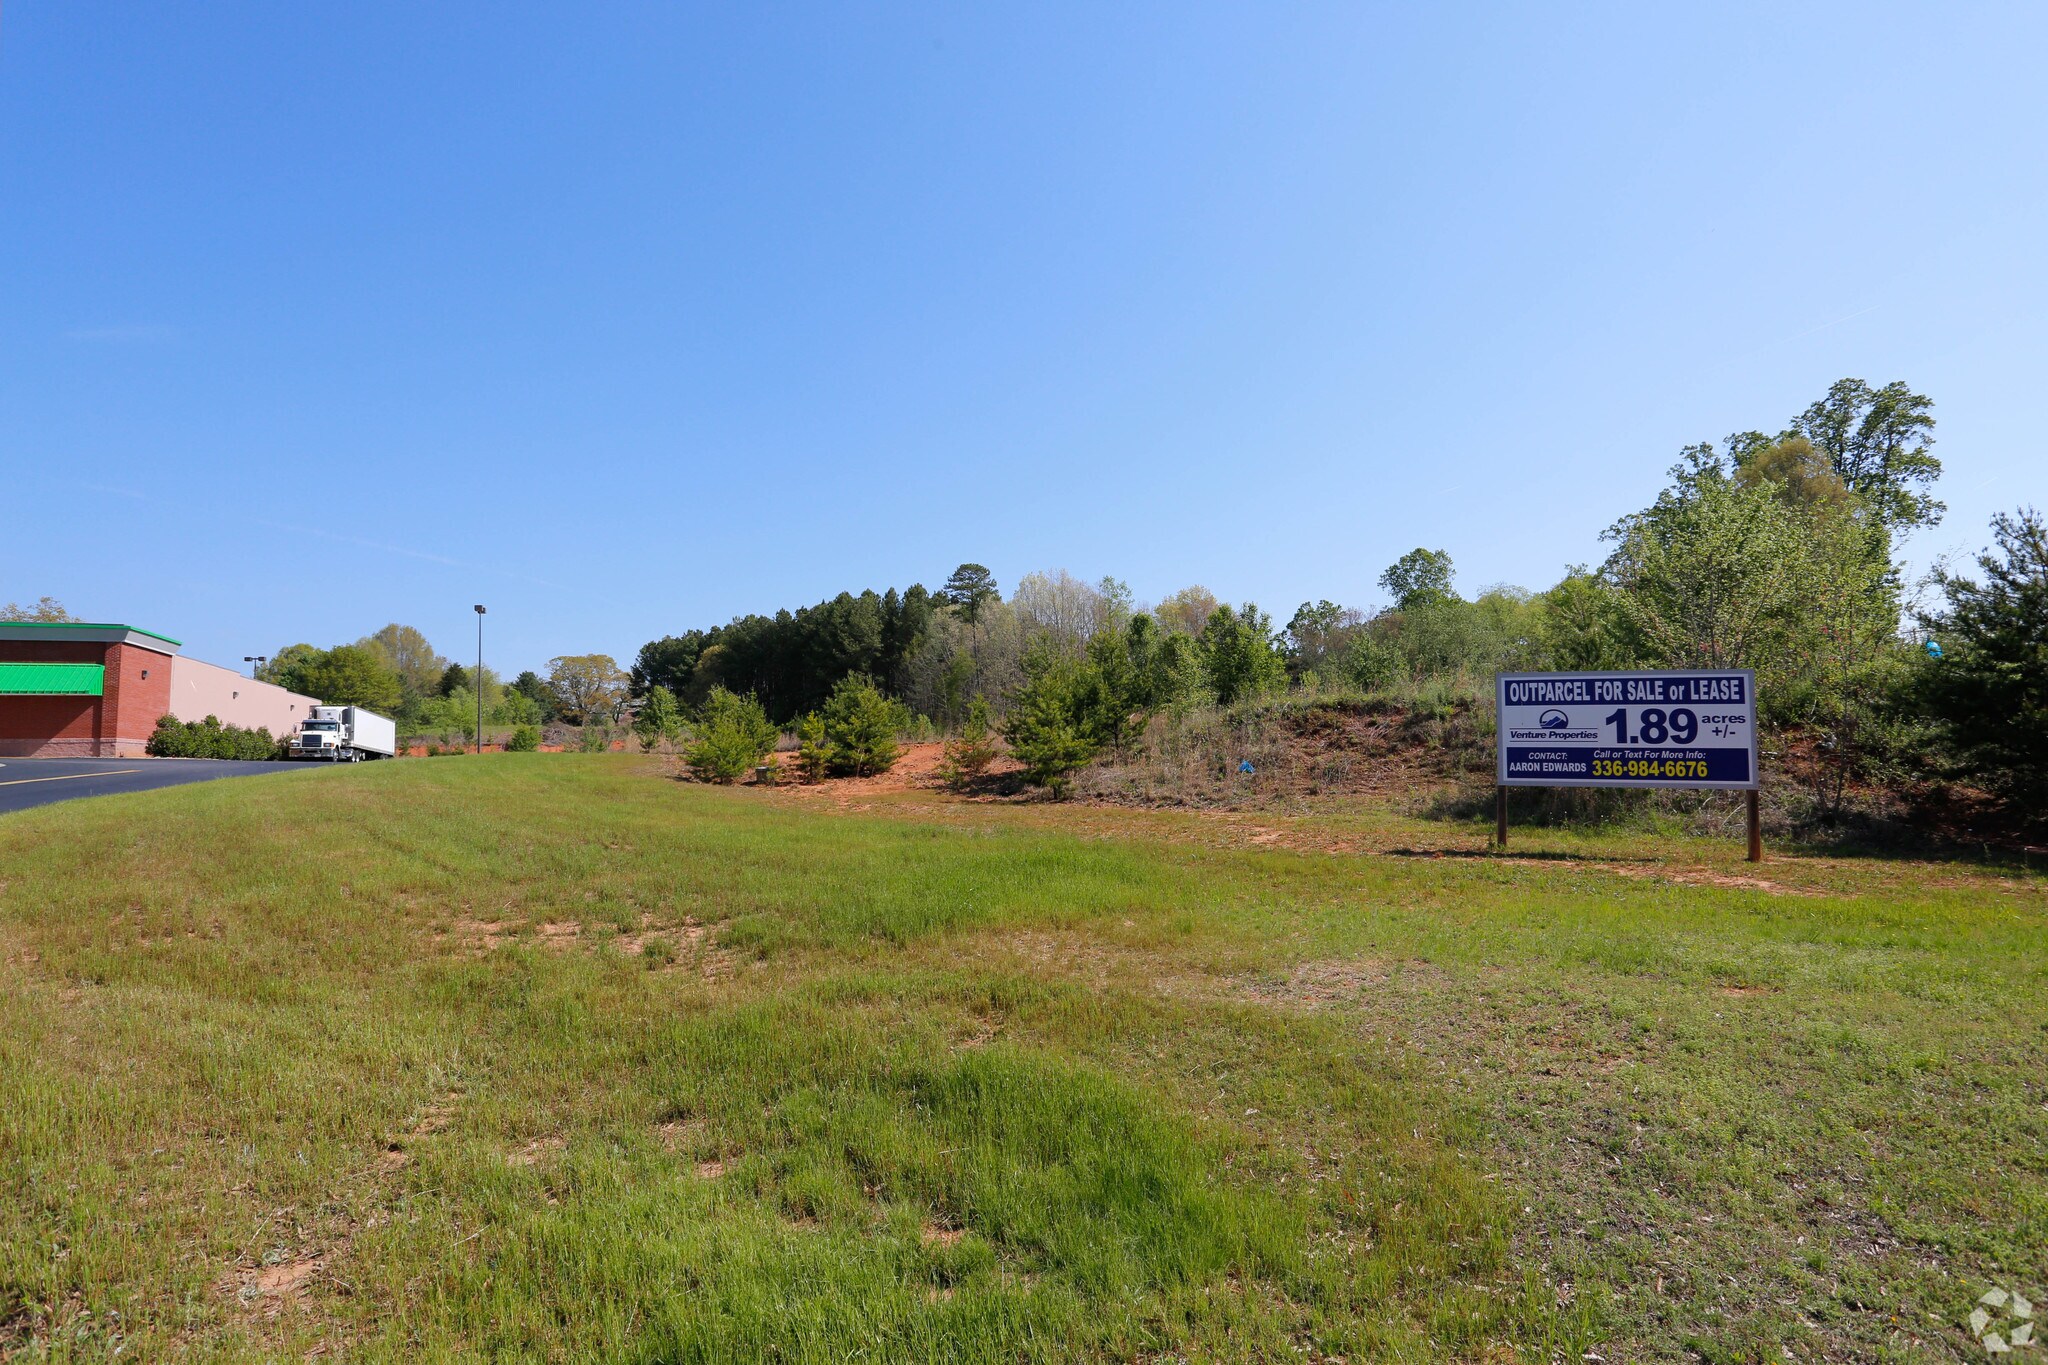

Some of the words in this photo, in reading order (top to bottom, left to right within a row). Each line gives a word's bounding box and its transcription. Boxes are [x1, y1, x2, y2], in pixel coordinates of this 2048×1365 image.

[1510, 682, 1590, 702] OUTPARCEL
[1595, 681, 1622, 701] FOR
[1627, 681, 1663, 701] SALE
[1669, 685, 1685, 701] or
[1690, 680, 1739, 700] LEASE
[1702, 714, 1746, 724] acres
[1606, 708, 1698, 744] 1.89
[1510, 731, 1547, 739] Venture
[1549, 731, 1598, 740] Properties
[1712, 725, 1735, 738] +/-
[1529, 752, 1567, 760] CONTACT:
[1593, 750, 1610, 758] Call
[1661, 751, 1683, 759] More
[1685, 751, 1706, 759] Info:
[1510, 763, 1540, 771] AARON
[1543, 763, 1586, 772] EDWARDS
